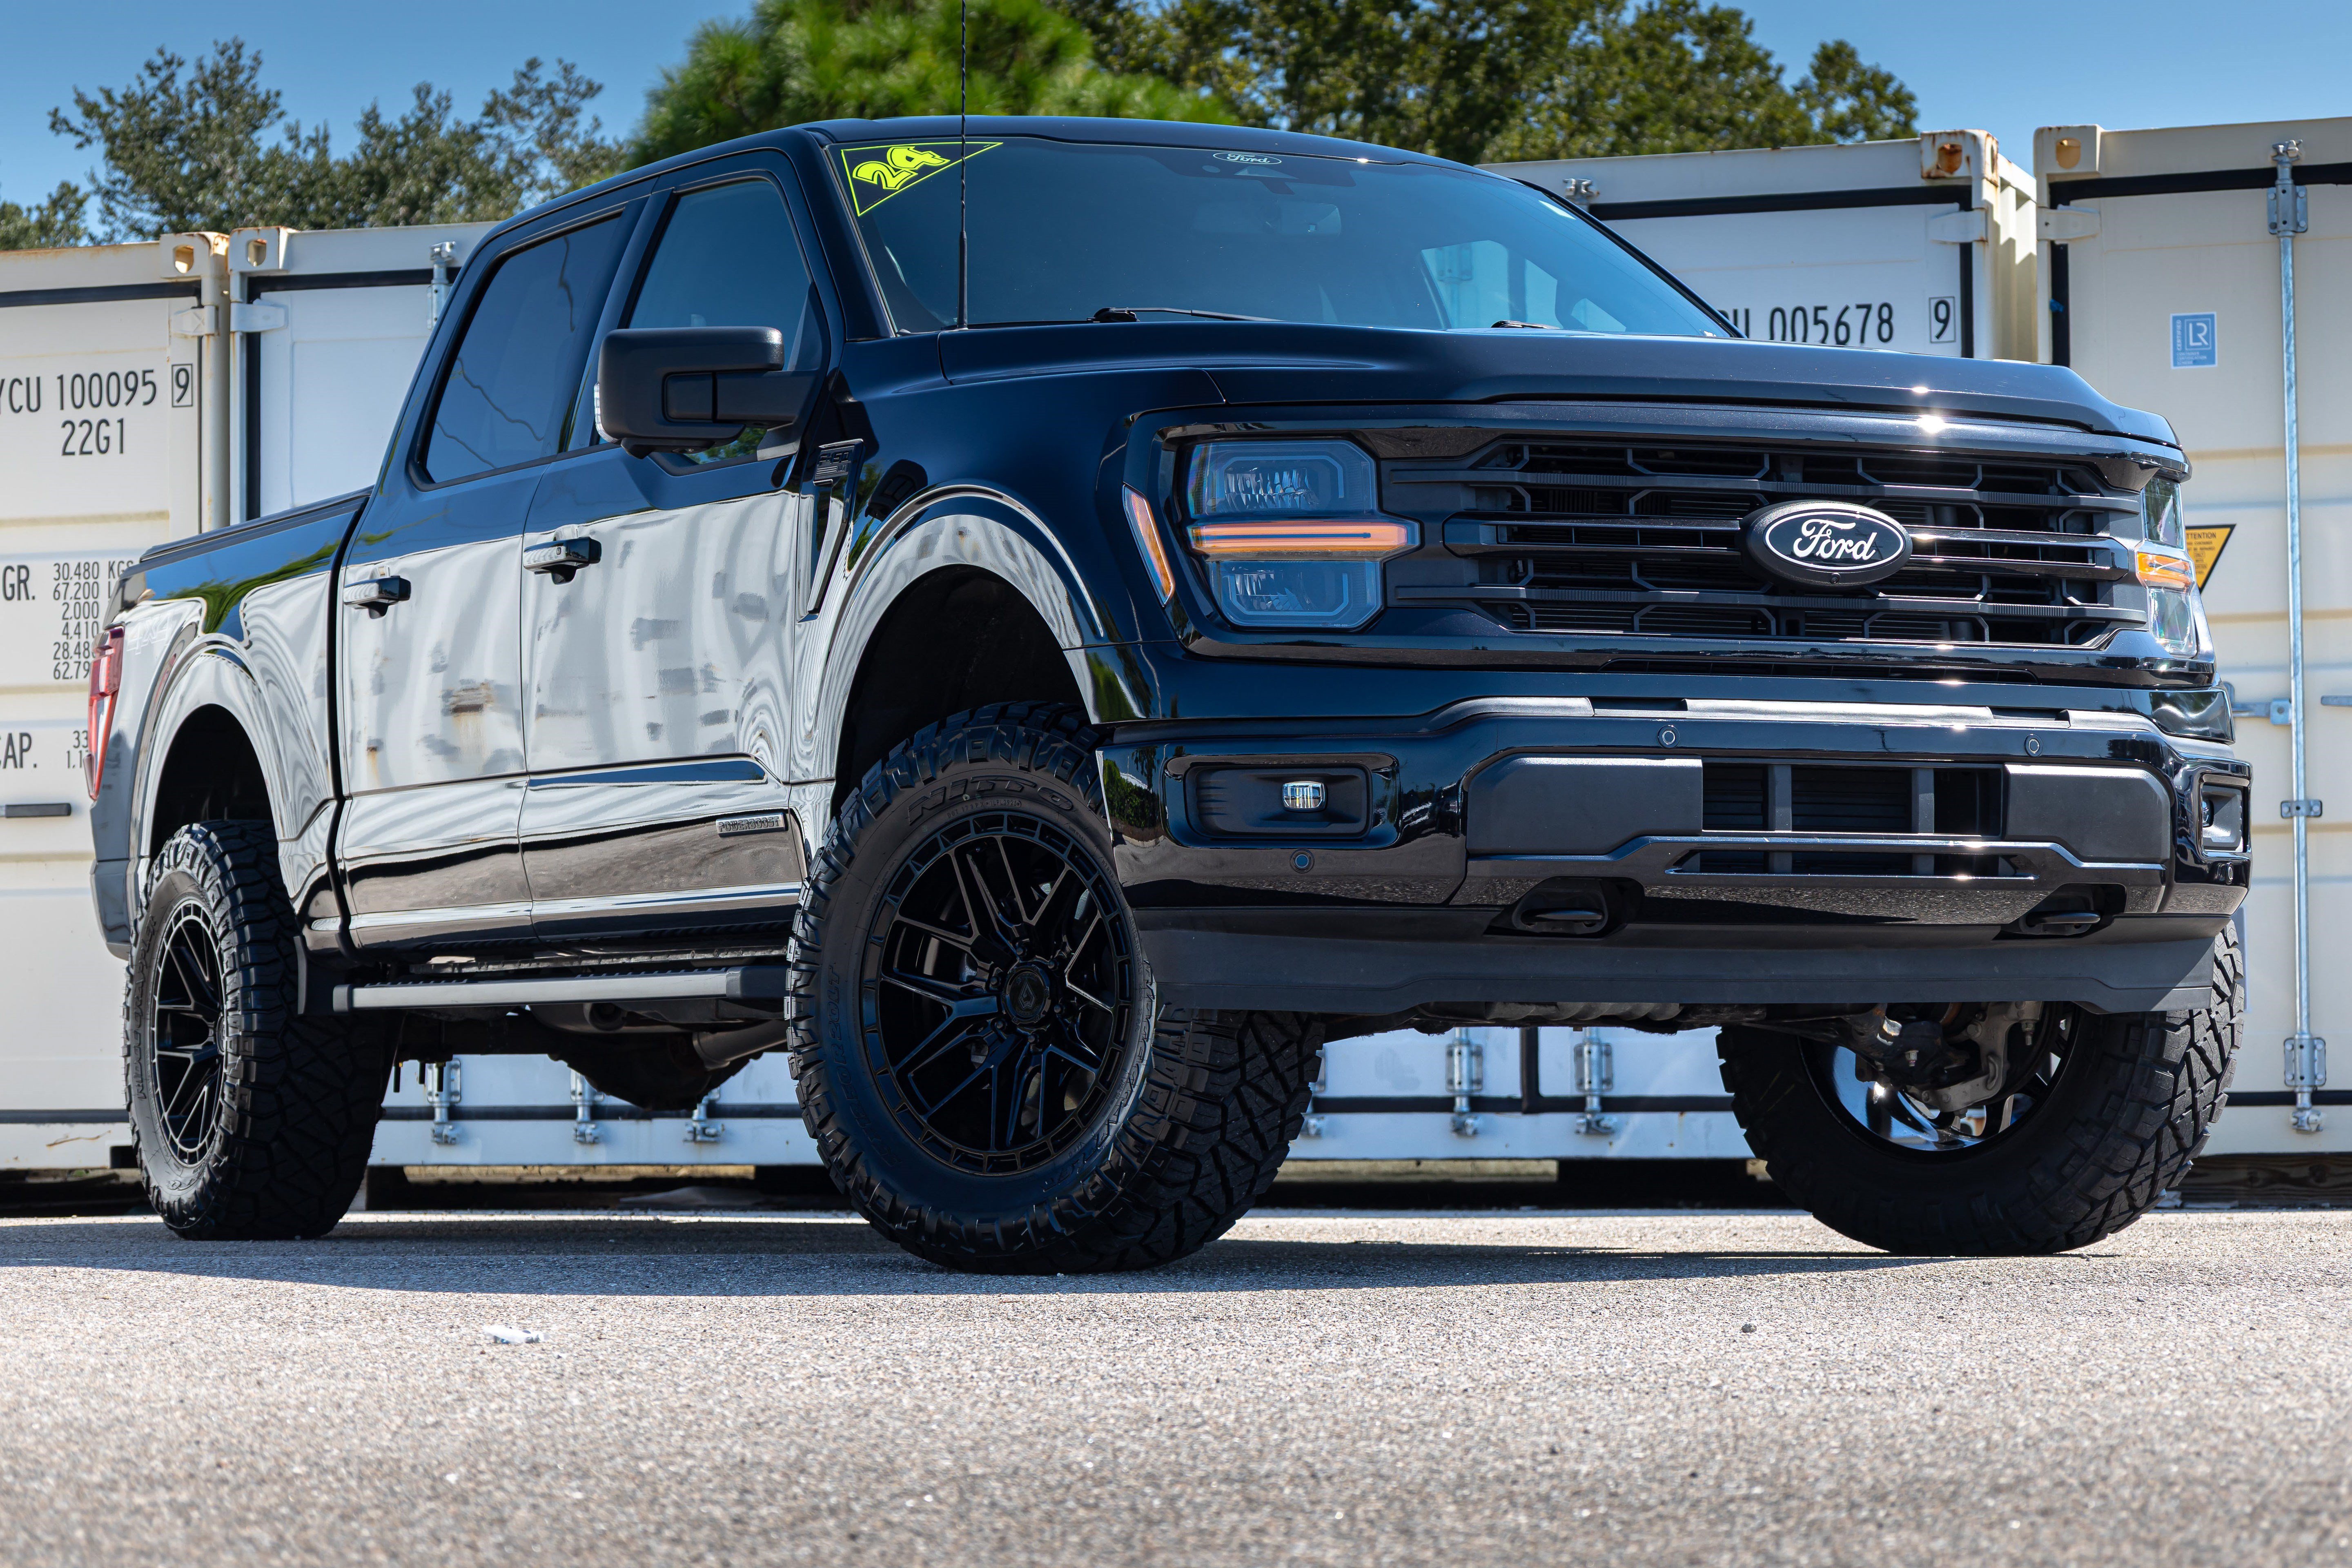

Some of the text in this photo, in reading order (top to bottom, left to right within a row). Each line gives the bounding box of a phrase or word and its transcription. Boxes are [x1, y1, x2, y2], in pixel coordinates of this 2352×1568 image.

[853, 146, 950, 190] 24
[1227, 153, 1270, 163] Ford
[1770, 301, 1894, 345] 005678
[1934, 299, 1950, 339] 9
[2189, 322, 2209, 346] LR
[57, 370, 157, 410] 100095
[175, 368, 190, 403] 9
[61, 417, 125, 456] 22G1
[1793, 518, 1878, 561] Ford
[2, 565, 36, 601] GR.
[53, 641, 96, 660] 28,48
[53, 661, 90, 680] 62,79
[0, 733, 37, 768] AP.
[907, 775, 1074, 826] NITTO
[719, 816, 779, 832] POWERBOOST
